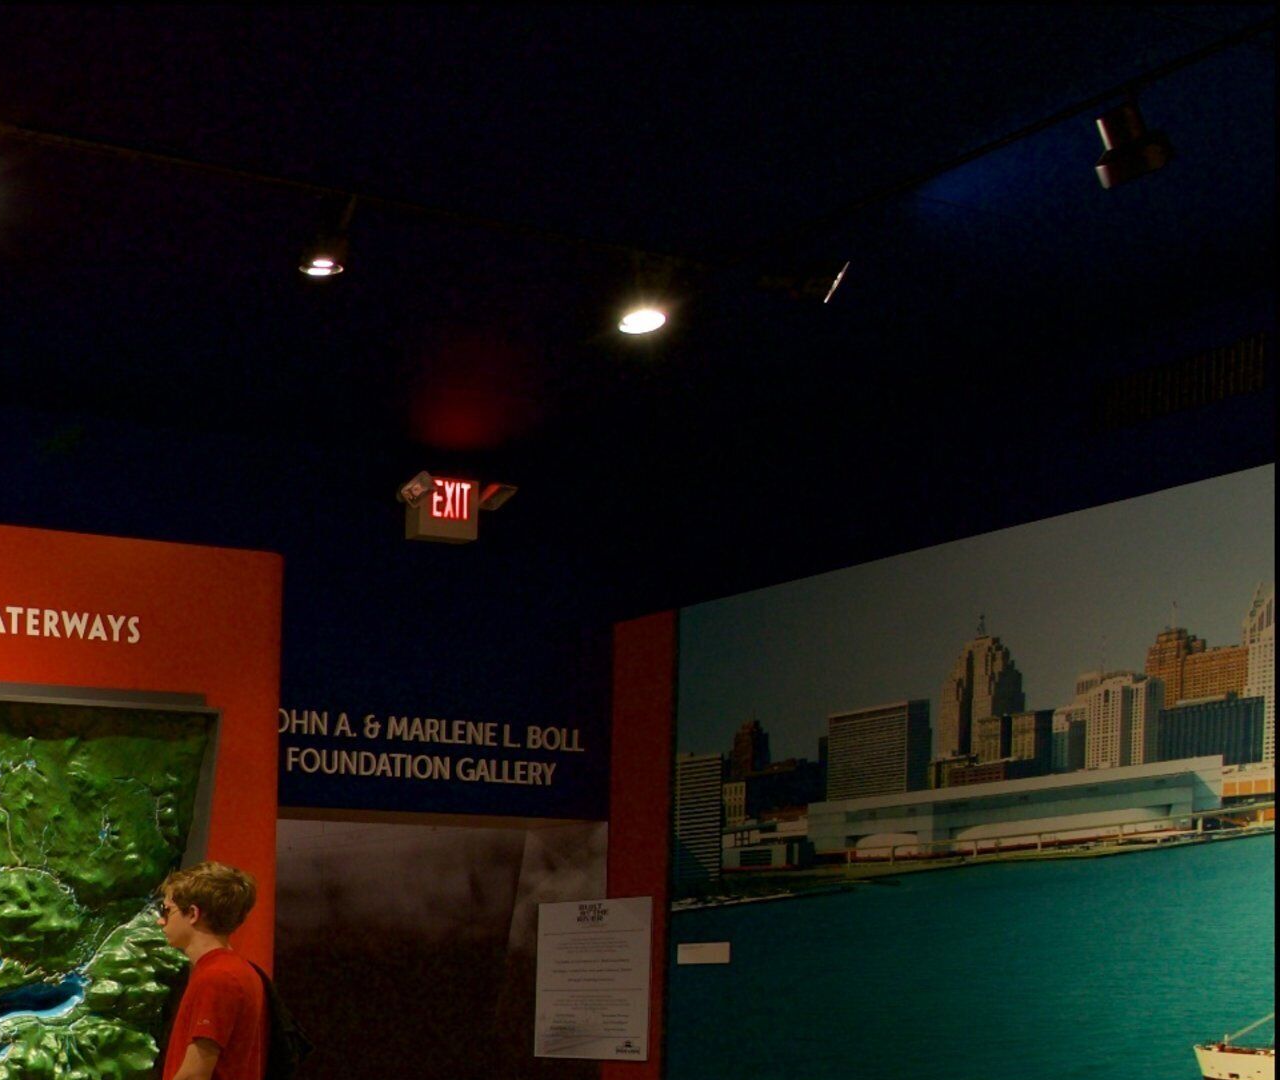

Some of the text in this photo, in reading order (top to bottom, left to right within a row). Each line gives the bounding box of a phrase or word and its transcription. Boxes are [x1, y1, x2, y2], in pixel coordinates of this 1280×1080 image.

[432, 479, 471, 520] EXIT
[334, 712, 357, 738] A.
[363, 714, 382, 739] &
[386, 715, 498, 747] MARLENE
[503, 723, 521, 748] L.
[527, 725, 585, 752] BOLL
[286, 746, 557, 786] FOUNDATION GALLERY
